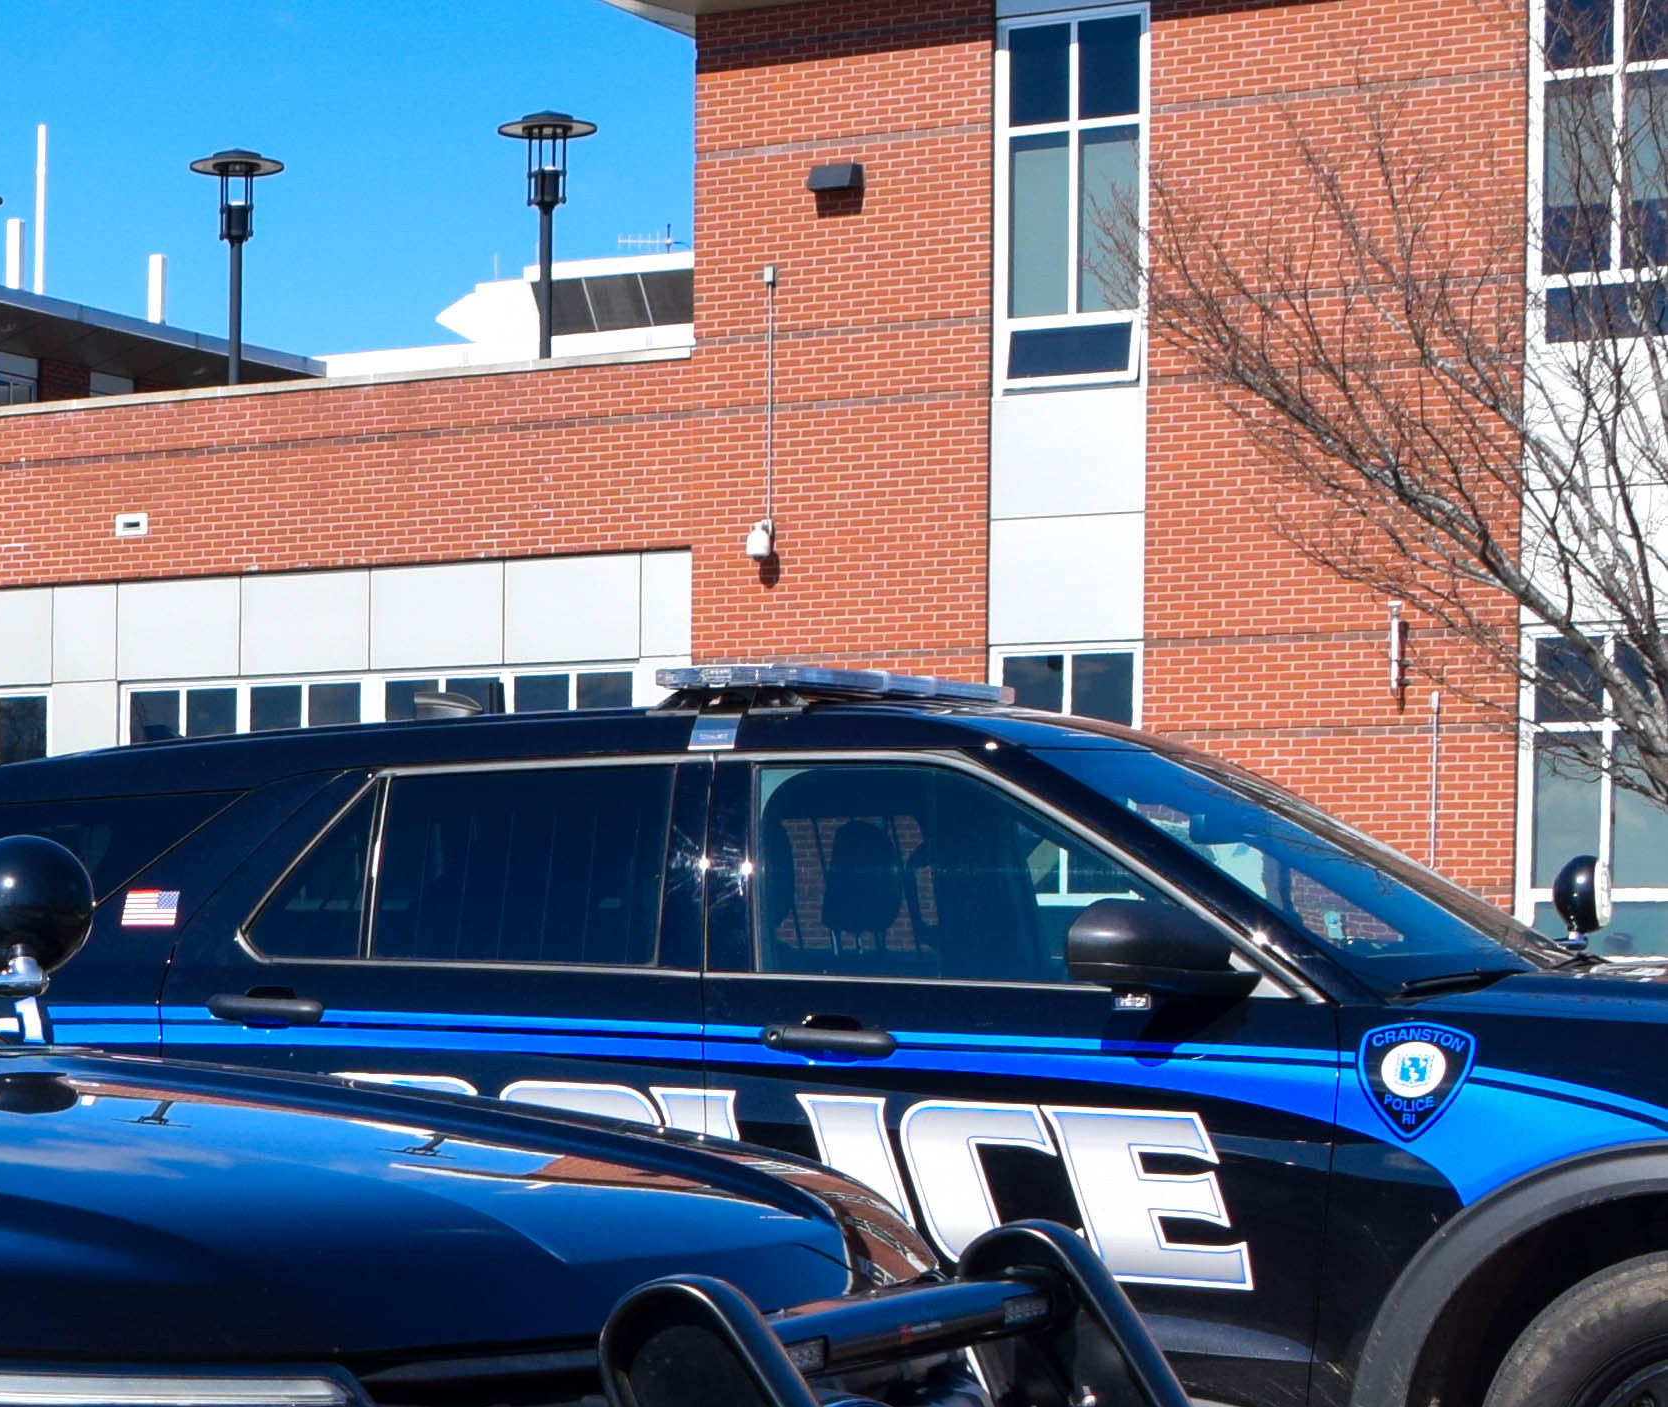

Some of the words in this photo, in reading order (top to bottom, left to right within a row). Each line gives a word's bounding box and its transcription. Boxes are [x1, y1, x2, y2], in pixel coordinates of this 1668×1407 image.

[1371, 1028, 1466, 1053] CRANSTON
[1384, 1093, 1435, 1112] POLICE
[1402, 1113, 1416, 1125] RI
[332, 1070, 1255, 1292] ICE
